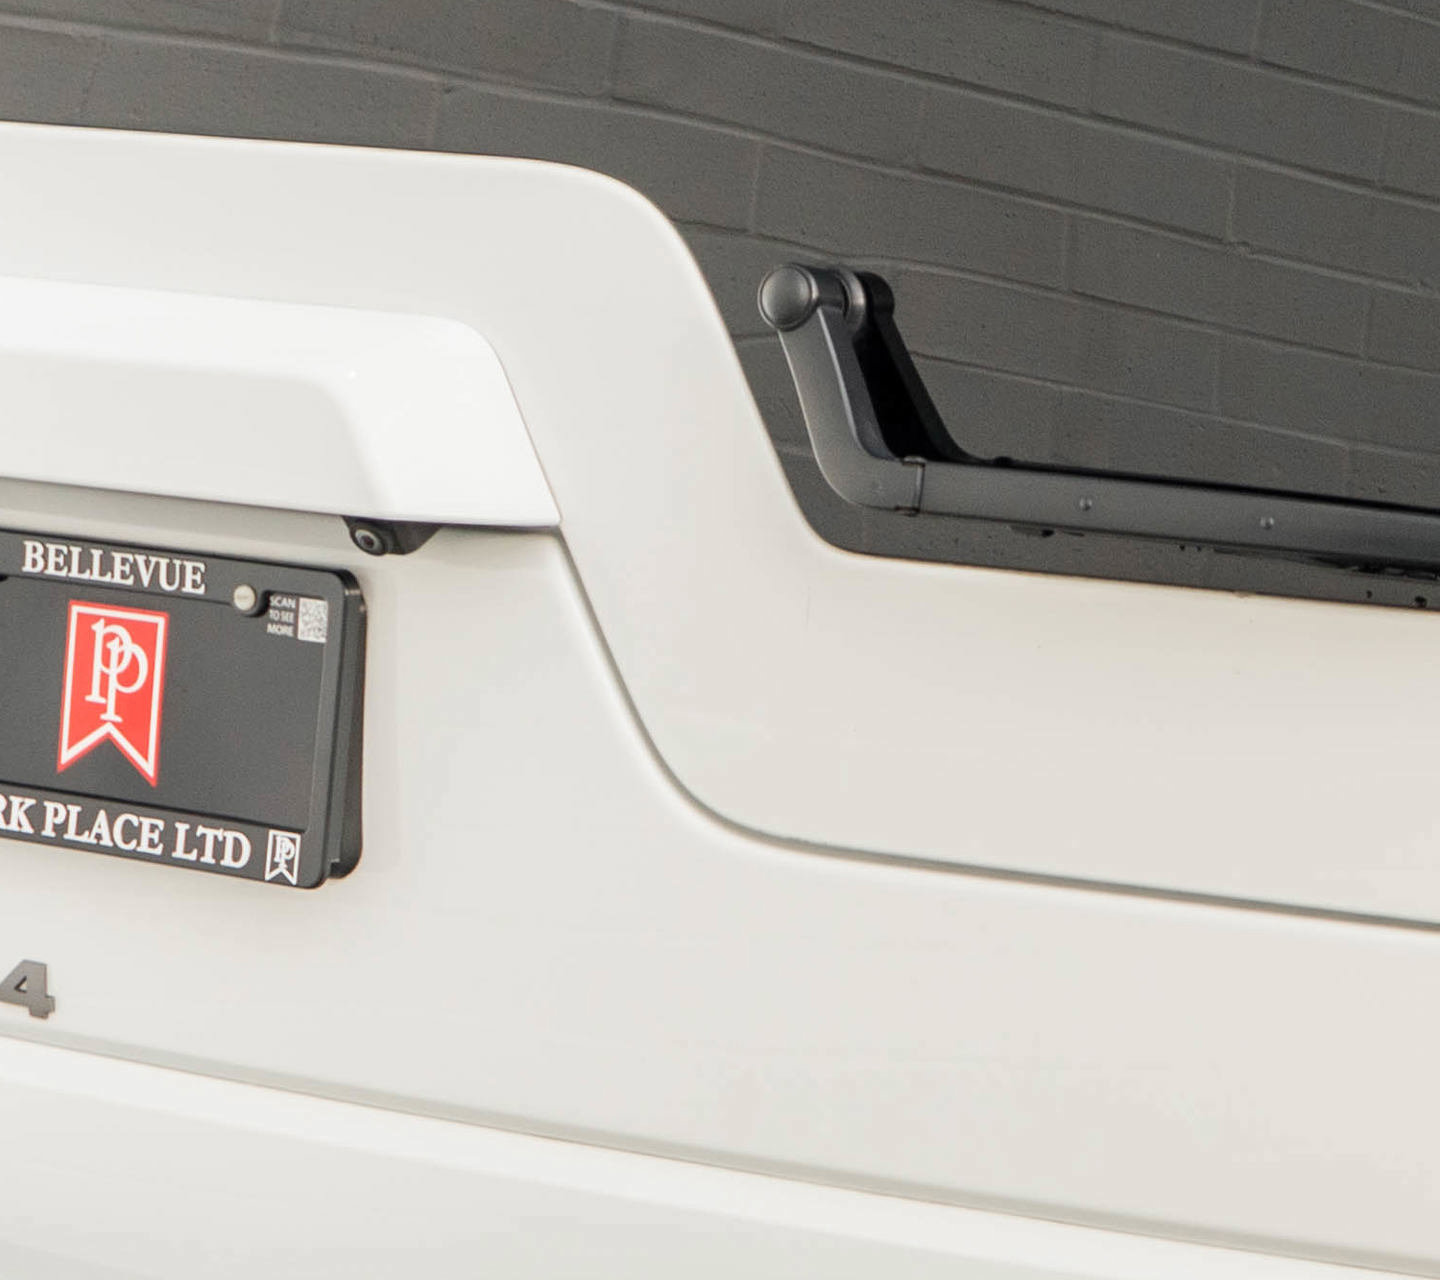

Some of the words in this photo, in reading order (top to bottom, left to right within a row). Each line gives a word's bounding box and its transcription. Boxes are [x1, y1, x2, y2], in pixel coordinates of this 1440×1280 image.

[21, 540, 207, 595] BELLEVUE
[269, 594, 296, 609] SCAN
[269, 608, 280, 622] TO
[266, 622, 295, 637] MORE
[42, 800, 165, 856] PLACE
[171, 821, 252, 870] LTD
